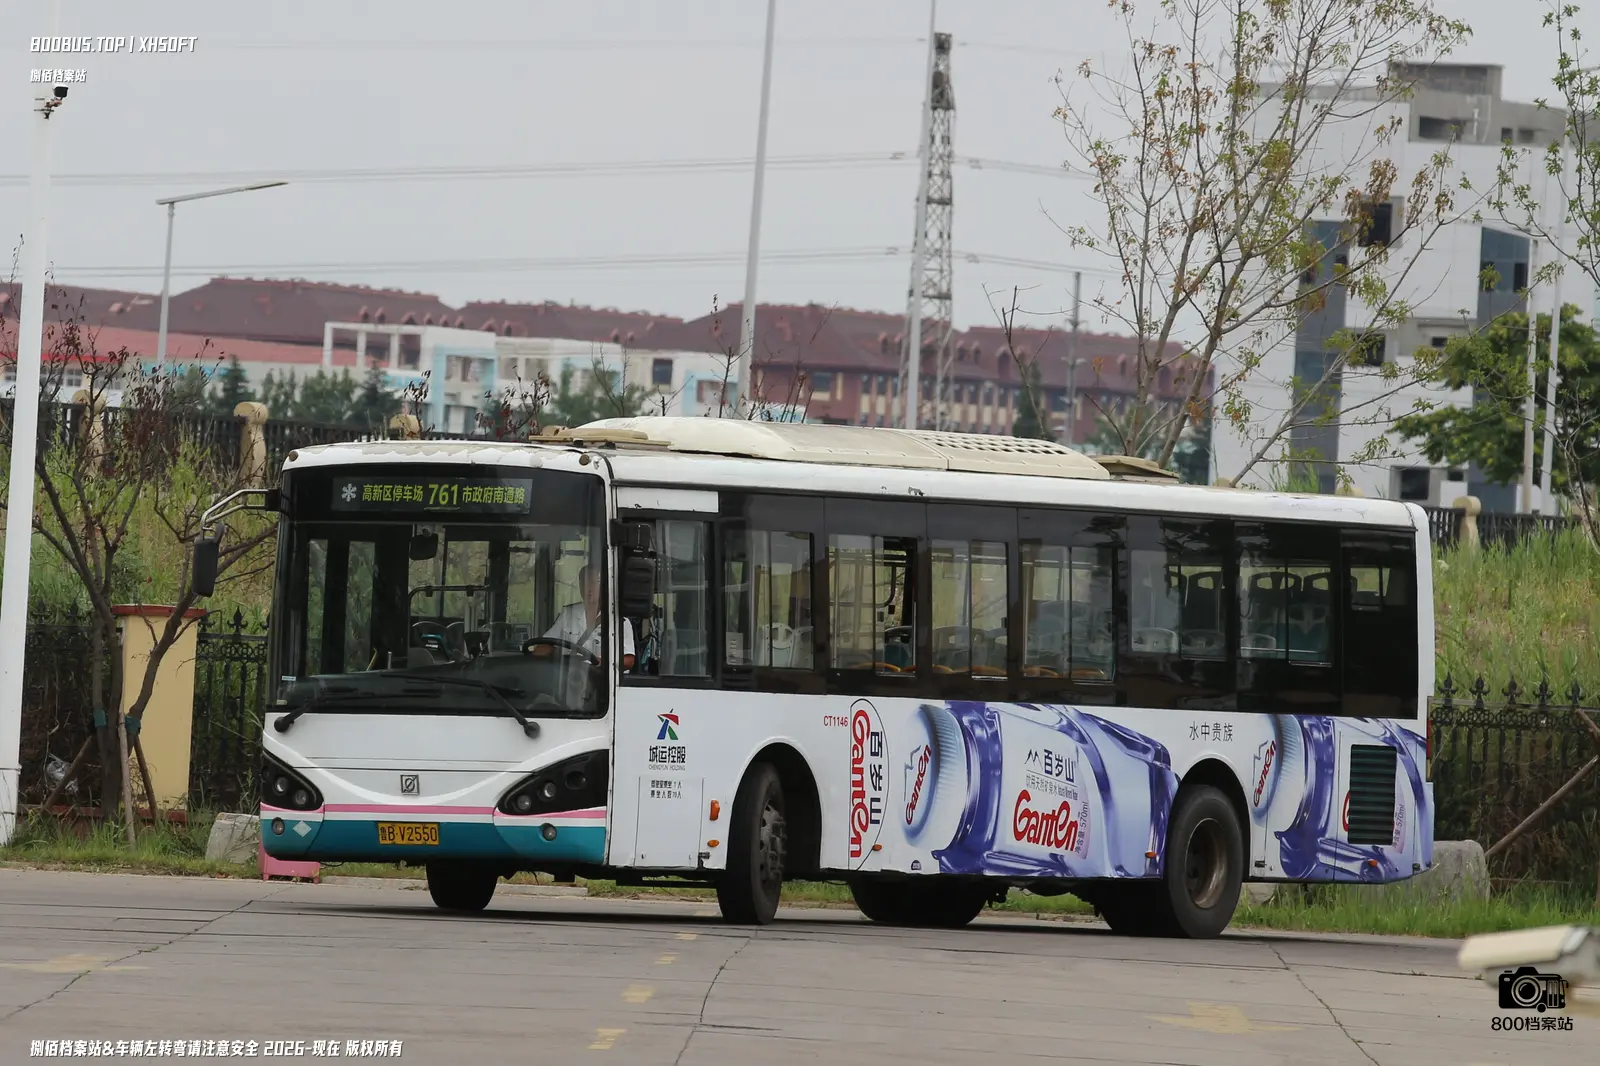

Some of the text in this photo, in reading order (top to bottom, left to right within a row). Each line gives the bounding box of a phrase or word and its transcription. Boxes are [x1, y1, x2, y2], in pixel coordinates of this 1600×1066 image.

[362, 484, 526, 505] 高新区停车场 761 市政府南通路
[823, 715, 848, 727] CT1146
[1189, 721, 1234, 742] 水中贵族
[649, 745, 686, 763] 城运控股
[1044, 748, 1075, 783] 百岁山
[869, 731, 883, 825] 百岁山
